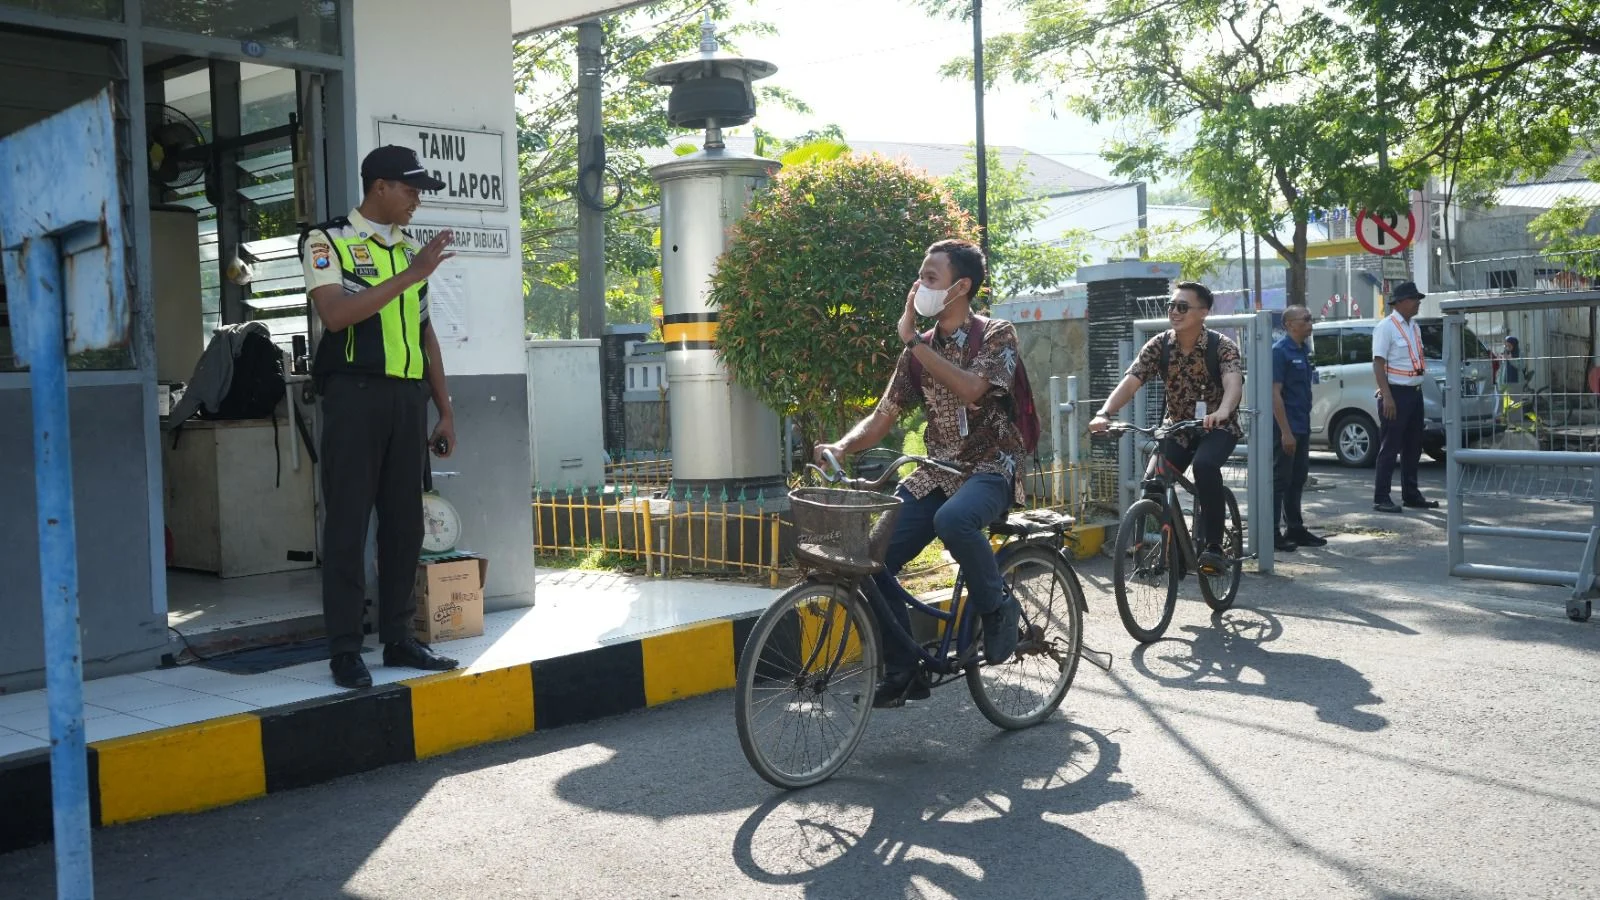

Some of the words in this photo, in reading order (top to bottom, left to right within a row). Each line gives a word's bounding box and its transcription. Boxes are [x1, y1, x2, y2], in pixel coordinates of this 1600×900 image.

[419, 132, 465, 162] TAMU
[448, 171, 501, 200] LAPOR
[448, 231, 471, 247] ARAP
[474, 232, 504, 248] DIBUKA
